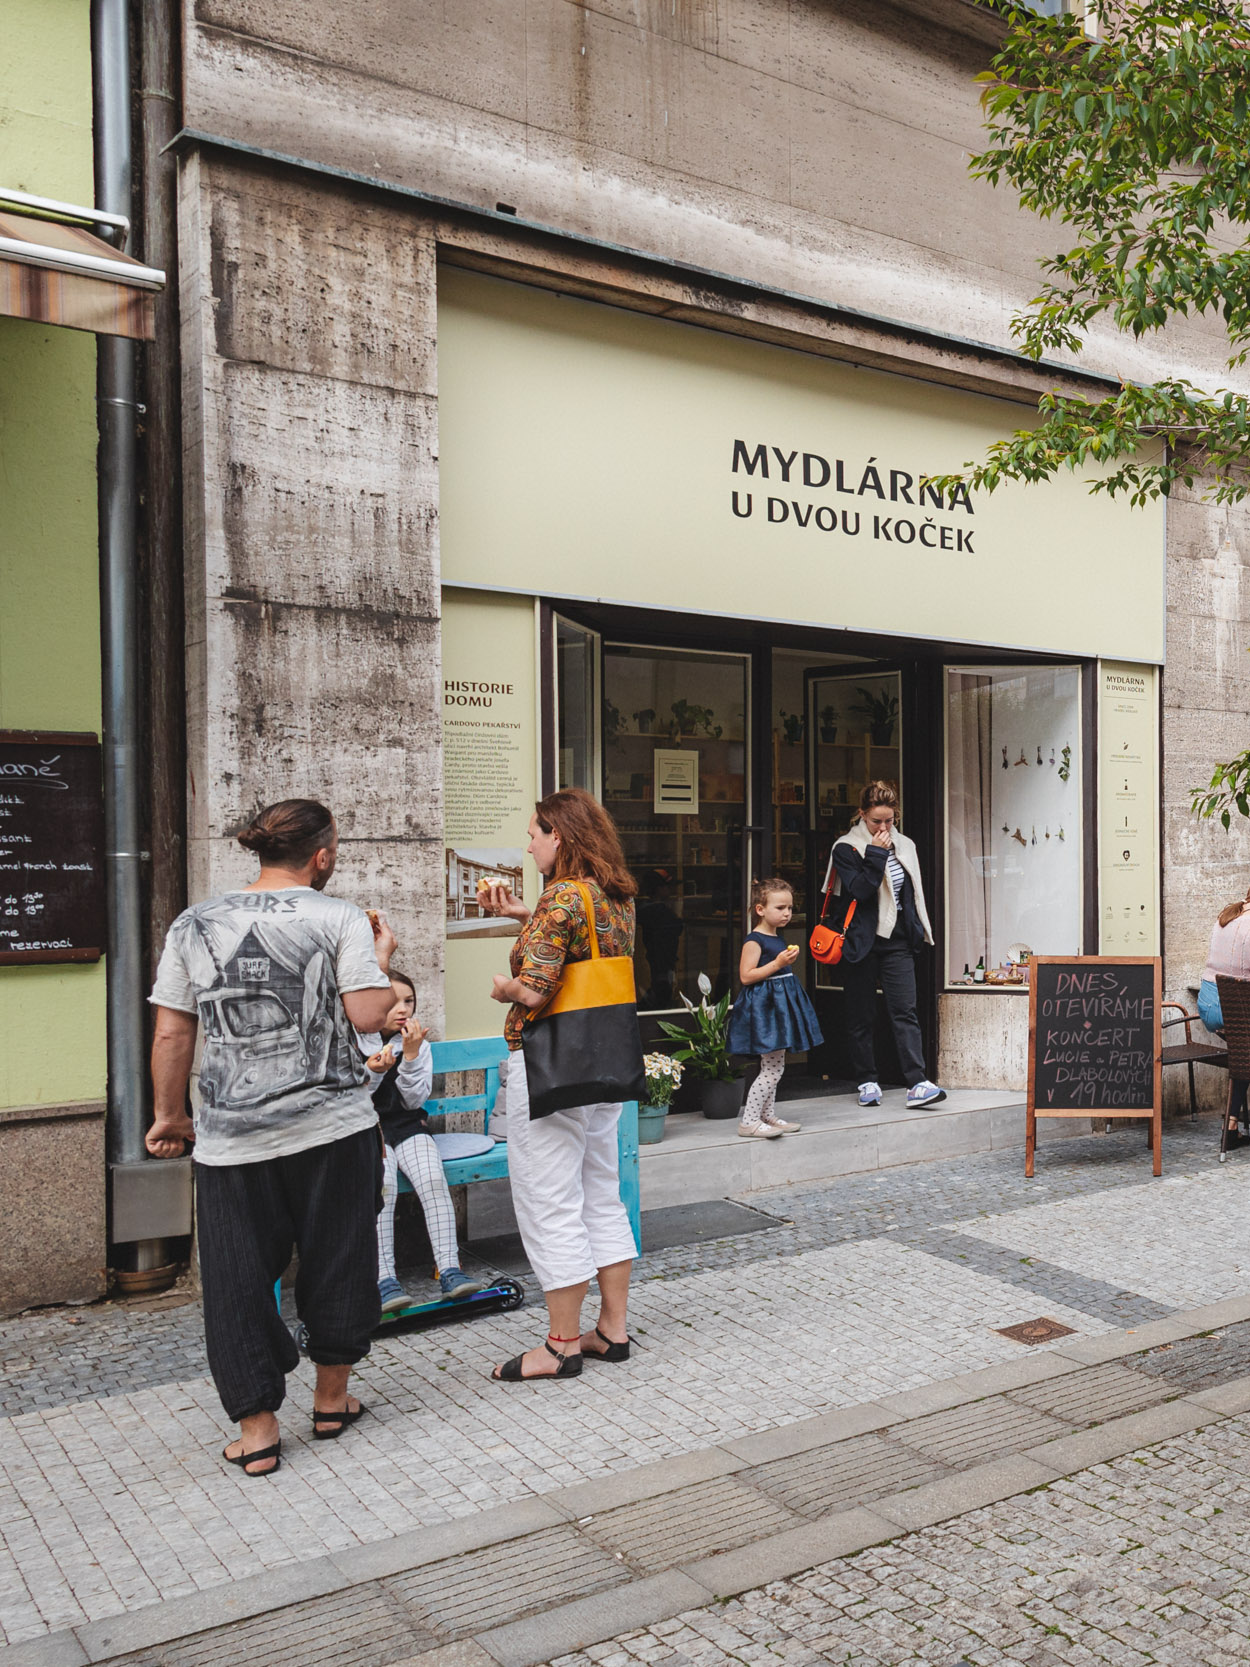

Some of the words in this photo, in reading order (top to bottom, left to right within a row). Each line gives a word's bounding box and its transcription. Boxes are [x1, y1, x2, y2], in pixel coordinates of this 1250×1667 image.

[732, 439, 974, 514] MYDLÁRNA
[732, 491, 752, 518] U
[768, 497, 860, 536] DVOU
[874, 516, 974, 553] KOČEK
[444, 680, 514, 694] HISTORIE
[1106, 675, 1145, 686] MYDLÁRNA
[445, 694, 492, 707] DOMU
[5, 894, 18, 904] do
[5, 906, 19, 916] do
[1043, 986, 1152, 1020] OTEVÍRÁME
[1070, 1082, 1096, 1106] 19
